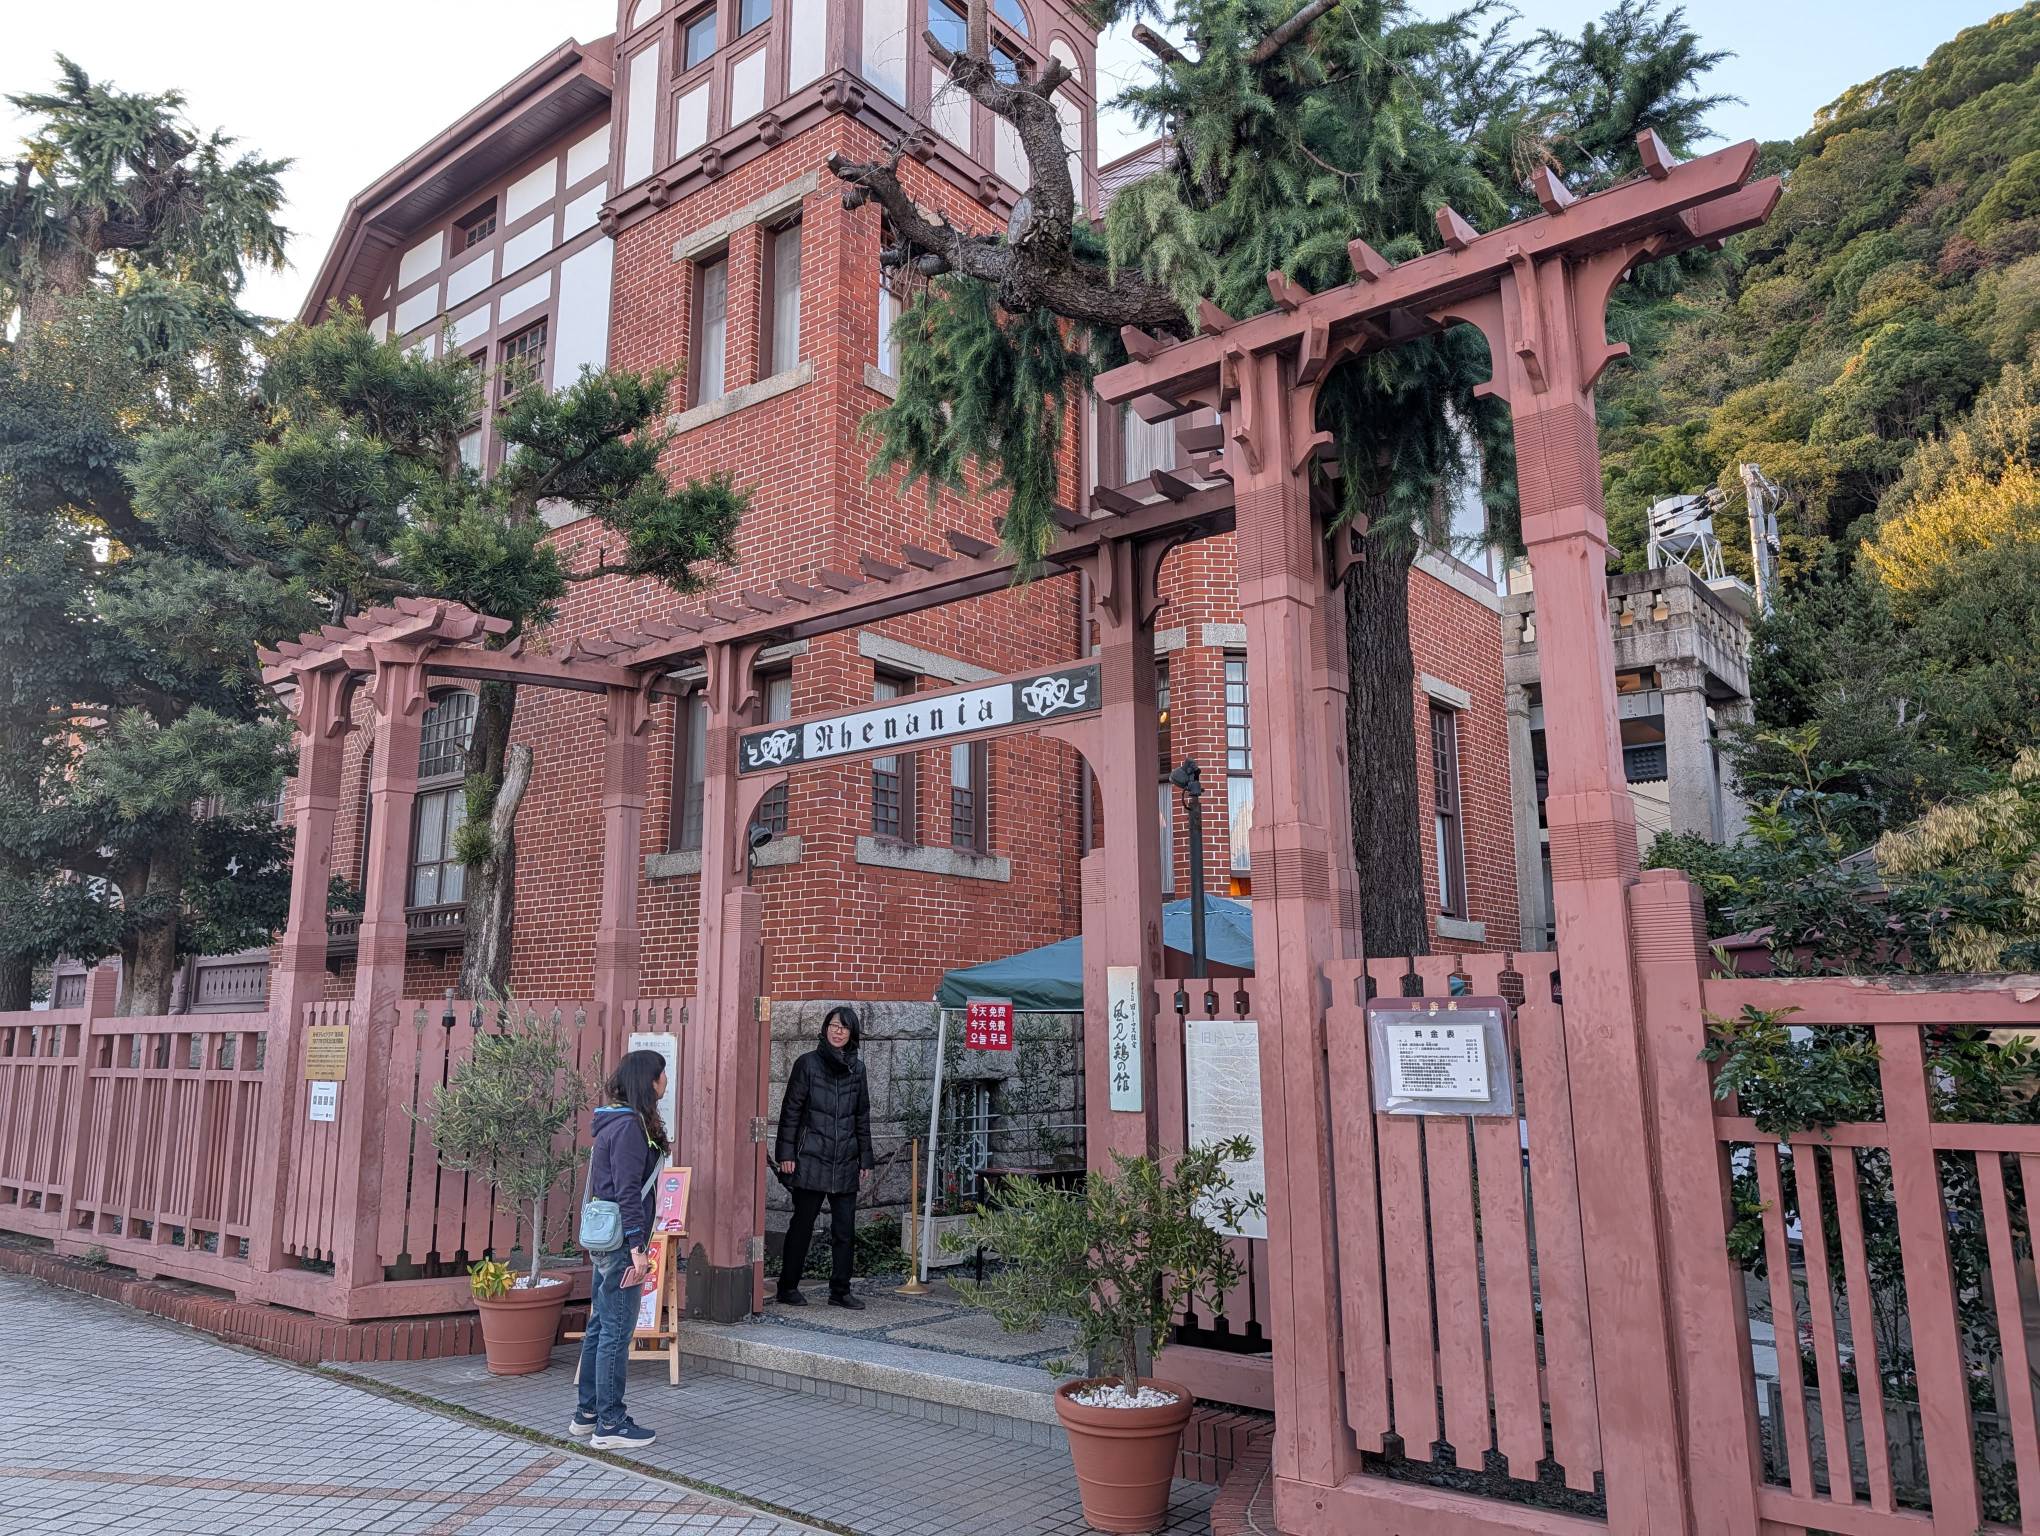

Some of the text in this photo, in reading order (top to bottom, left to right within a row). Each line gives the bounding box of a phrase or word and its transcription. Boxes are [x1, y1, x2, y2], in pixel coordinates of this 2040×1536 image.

[815, 696, 995, 753] Rhenania
[970, 1006, 987, 1017] 今天
[970, 1019, 987, 1030] 今天
[970, 1032, 1008, 1045] 오늘 무료
[1414, 1029, 1455, 1039] 料金表
[1113, 999, 1130, 1093] 風見鶏の館
